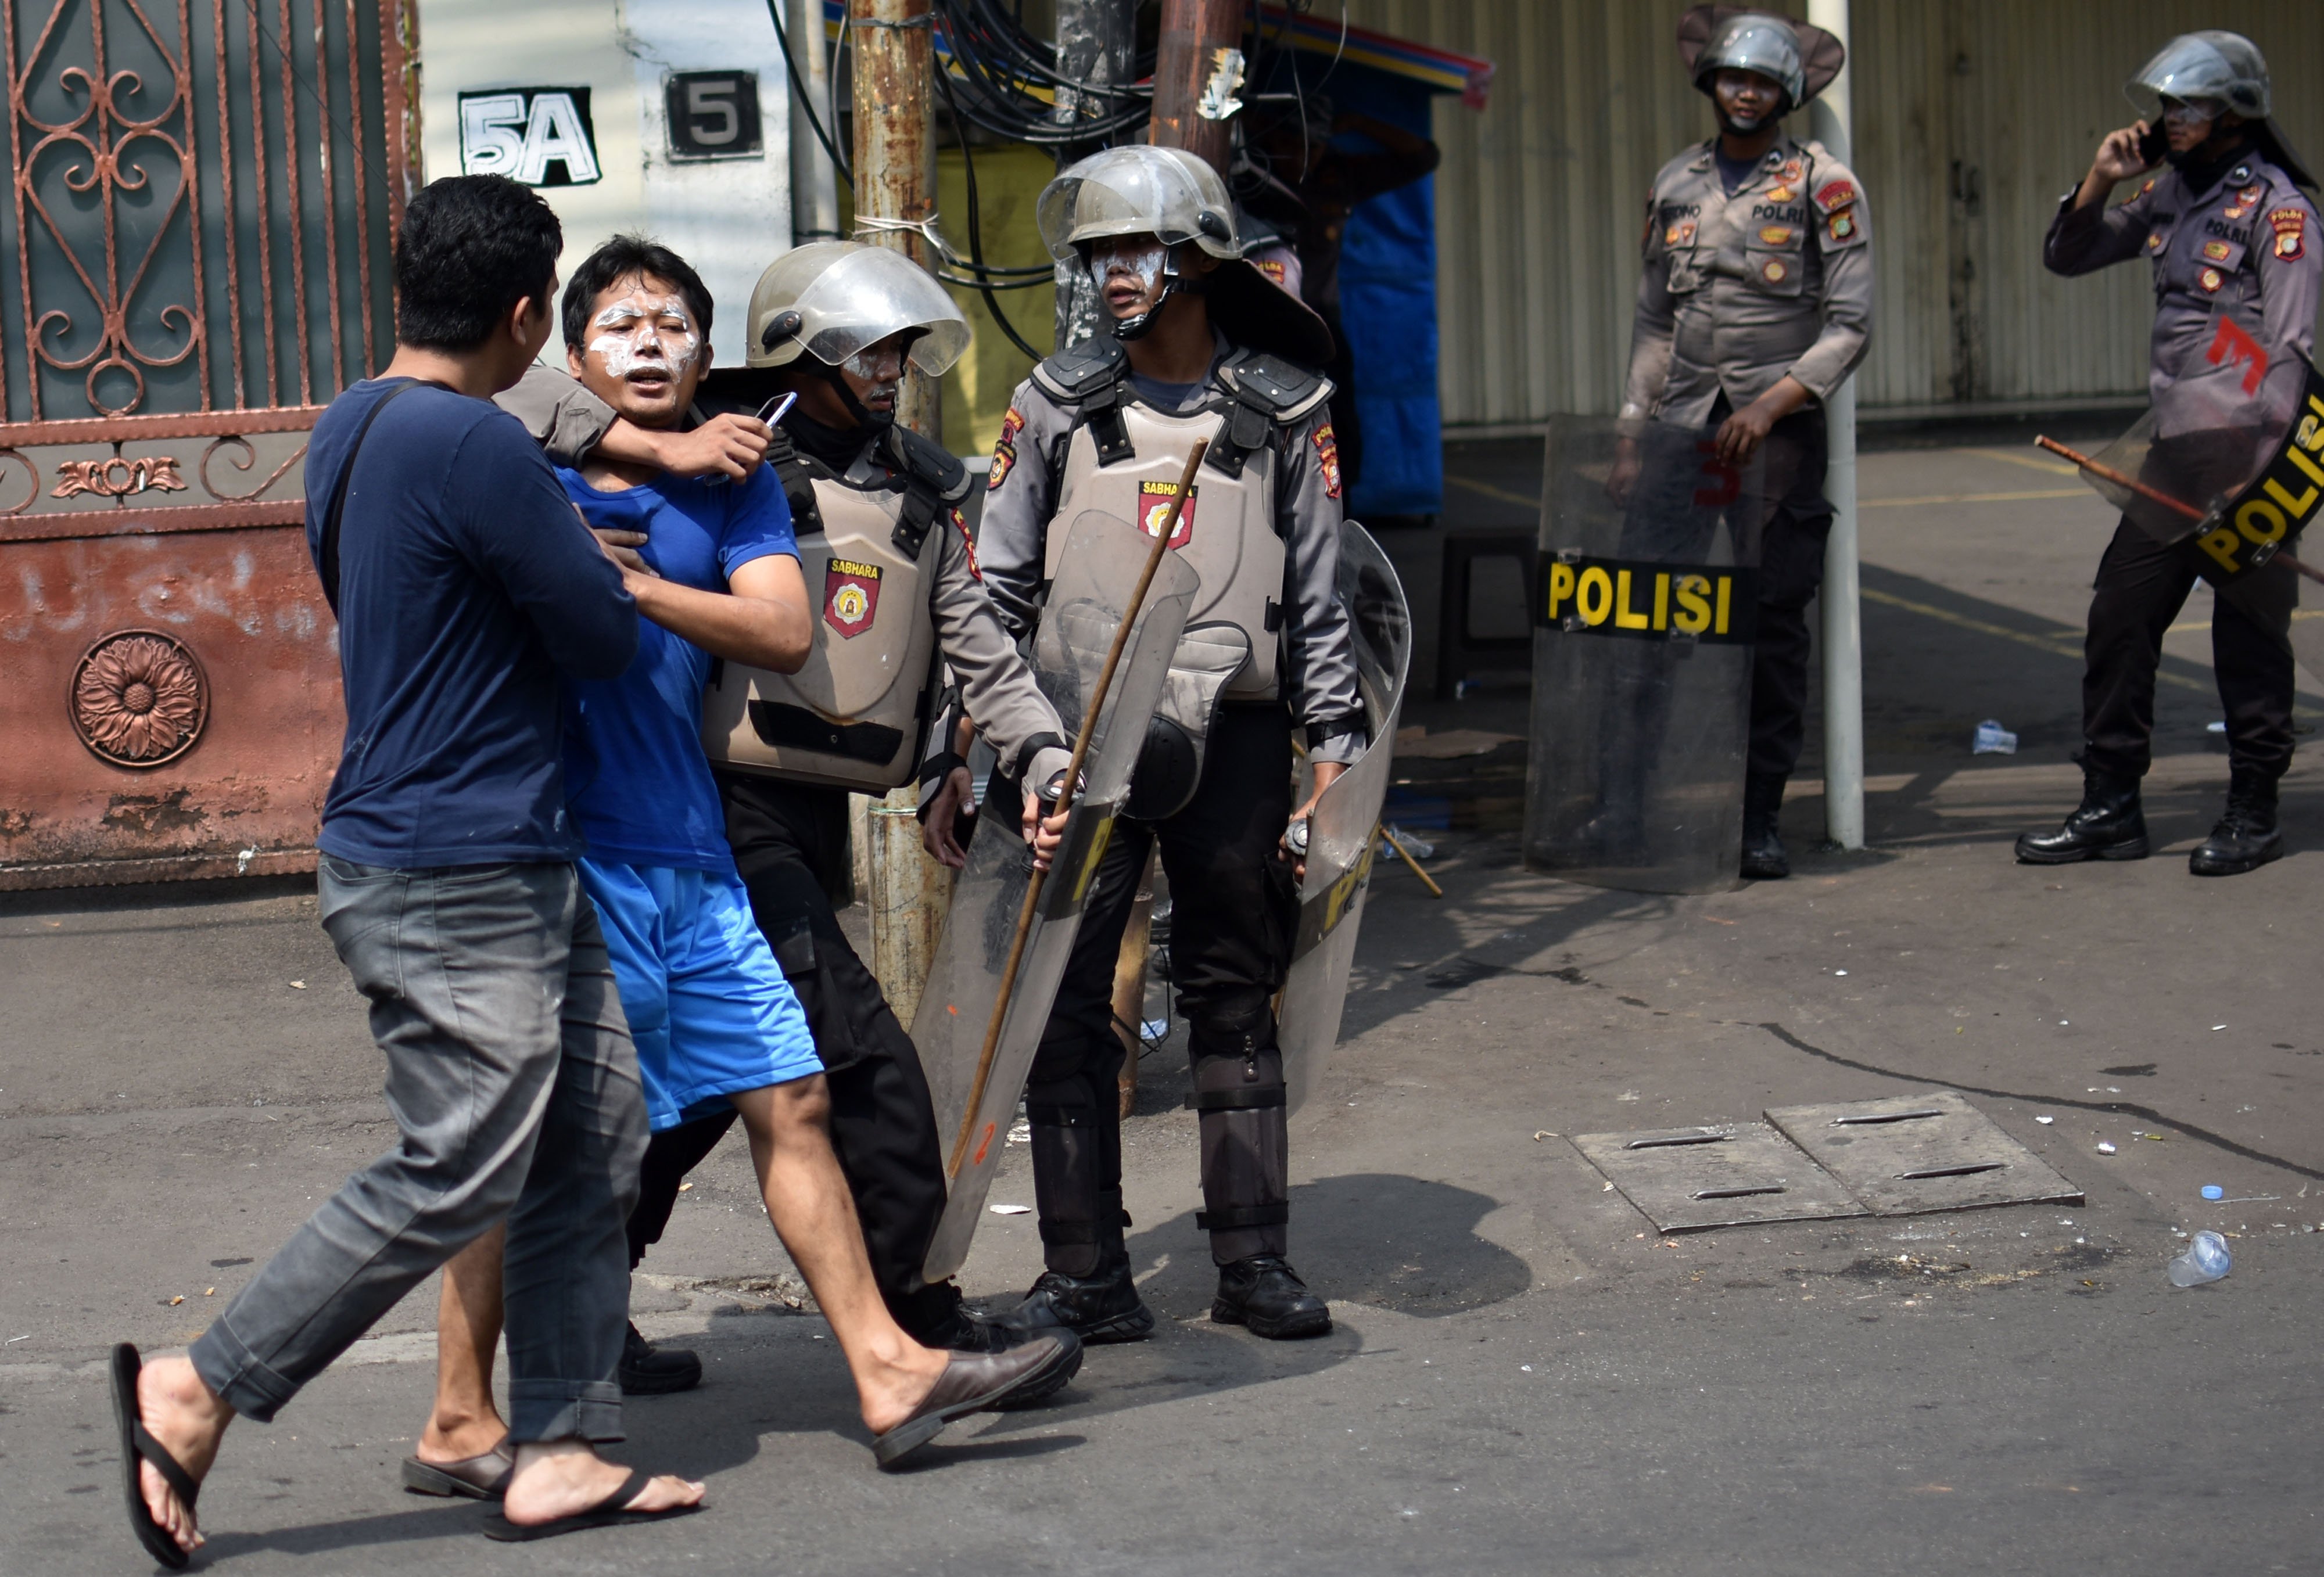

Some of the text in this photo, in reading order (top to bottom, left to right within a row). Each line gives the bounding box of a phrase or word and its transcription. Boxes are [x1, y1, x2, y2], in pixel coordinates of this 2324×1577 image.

[688, 81, 738, 145] 5
[461, 93, 598, 182] 5A
[1752, 204, 1805, 223] POLRI
[2205, 218, 2247, 244] POLRI
[831, 559, 878, 579] SABHARA
[1548, 562, 1731, 634] POLISI
